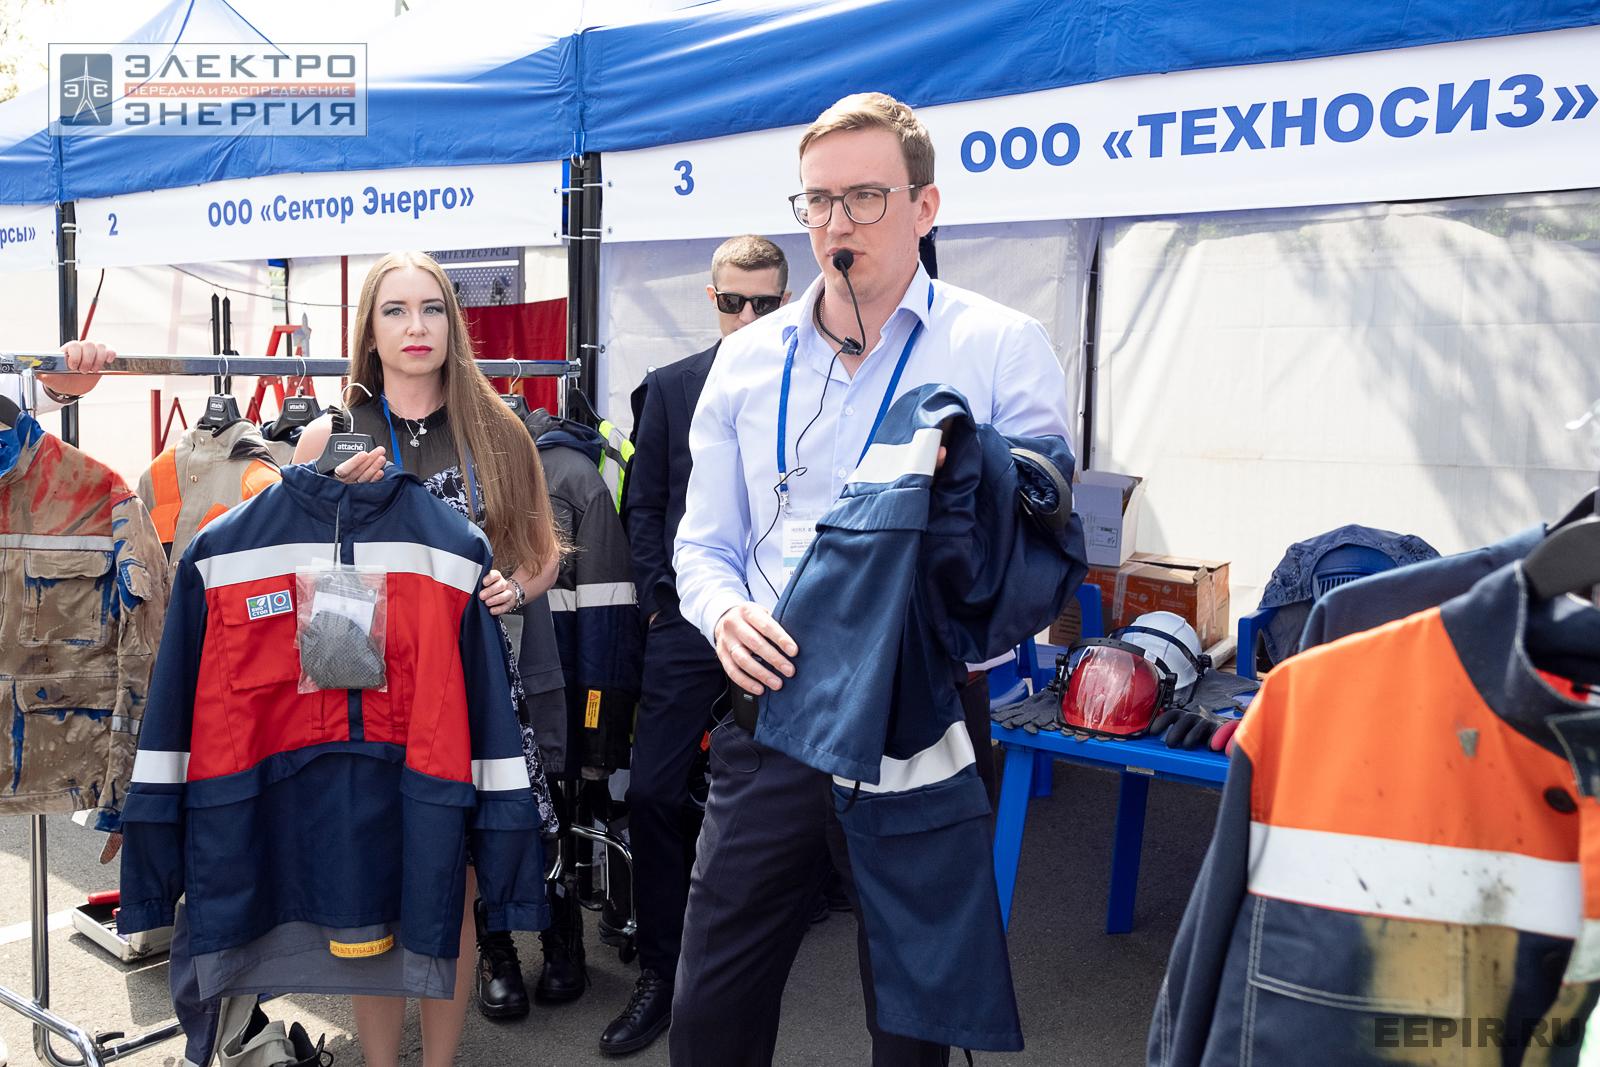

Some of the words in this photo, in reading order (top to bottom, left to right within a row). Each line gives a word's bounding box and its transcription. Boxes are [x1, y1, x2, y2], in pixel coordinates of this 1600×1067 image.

[960, 122, 1081, 173] ООО
[1102, 74, 1599, 159] «ТЕХНОСИЗ»
[674, 160, 694, 196] 3
[107, 213, 118, 236] 2
[208, 198, 252, 227] ООО
[260, 194, 354, 224] «Сектор
[362, 186, 474, 219] Энерго»
